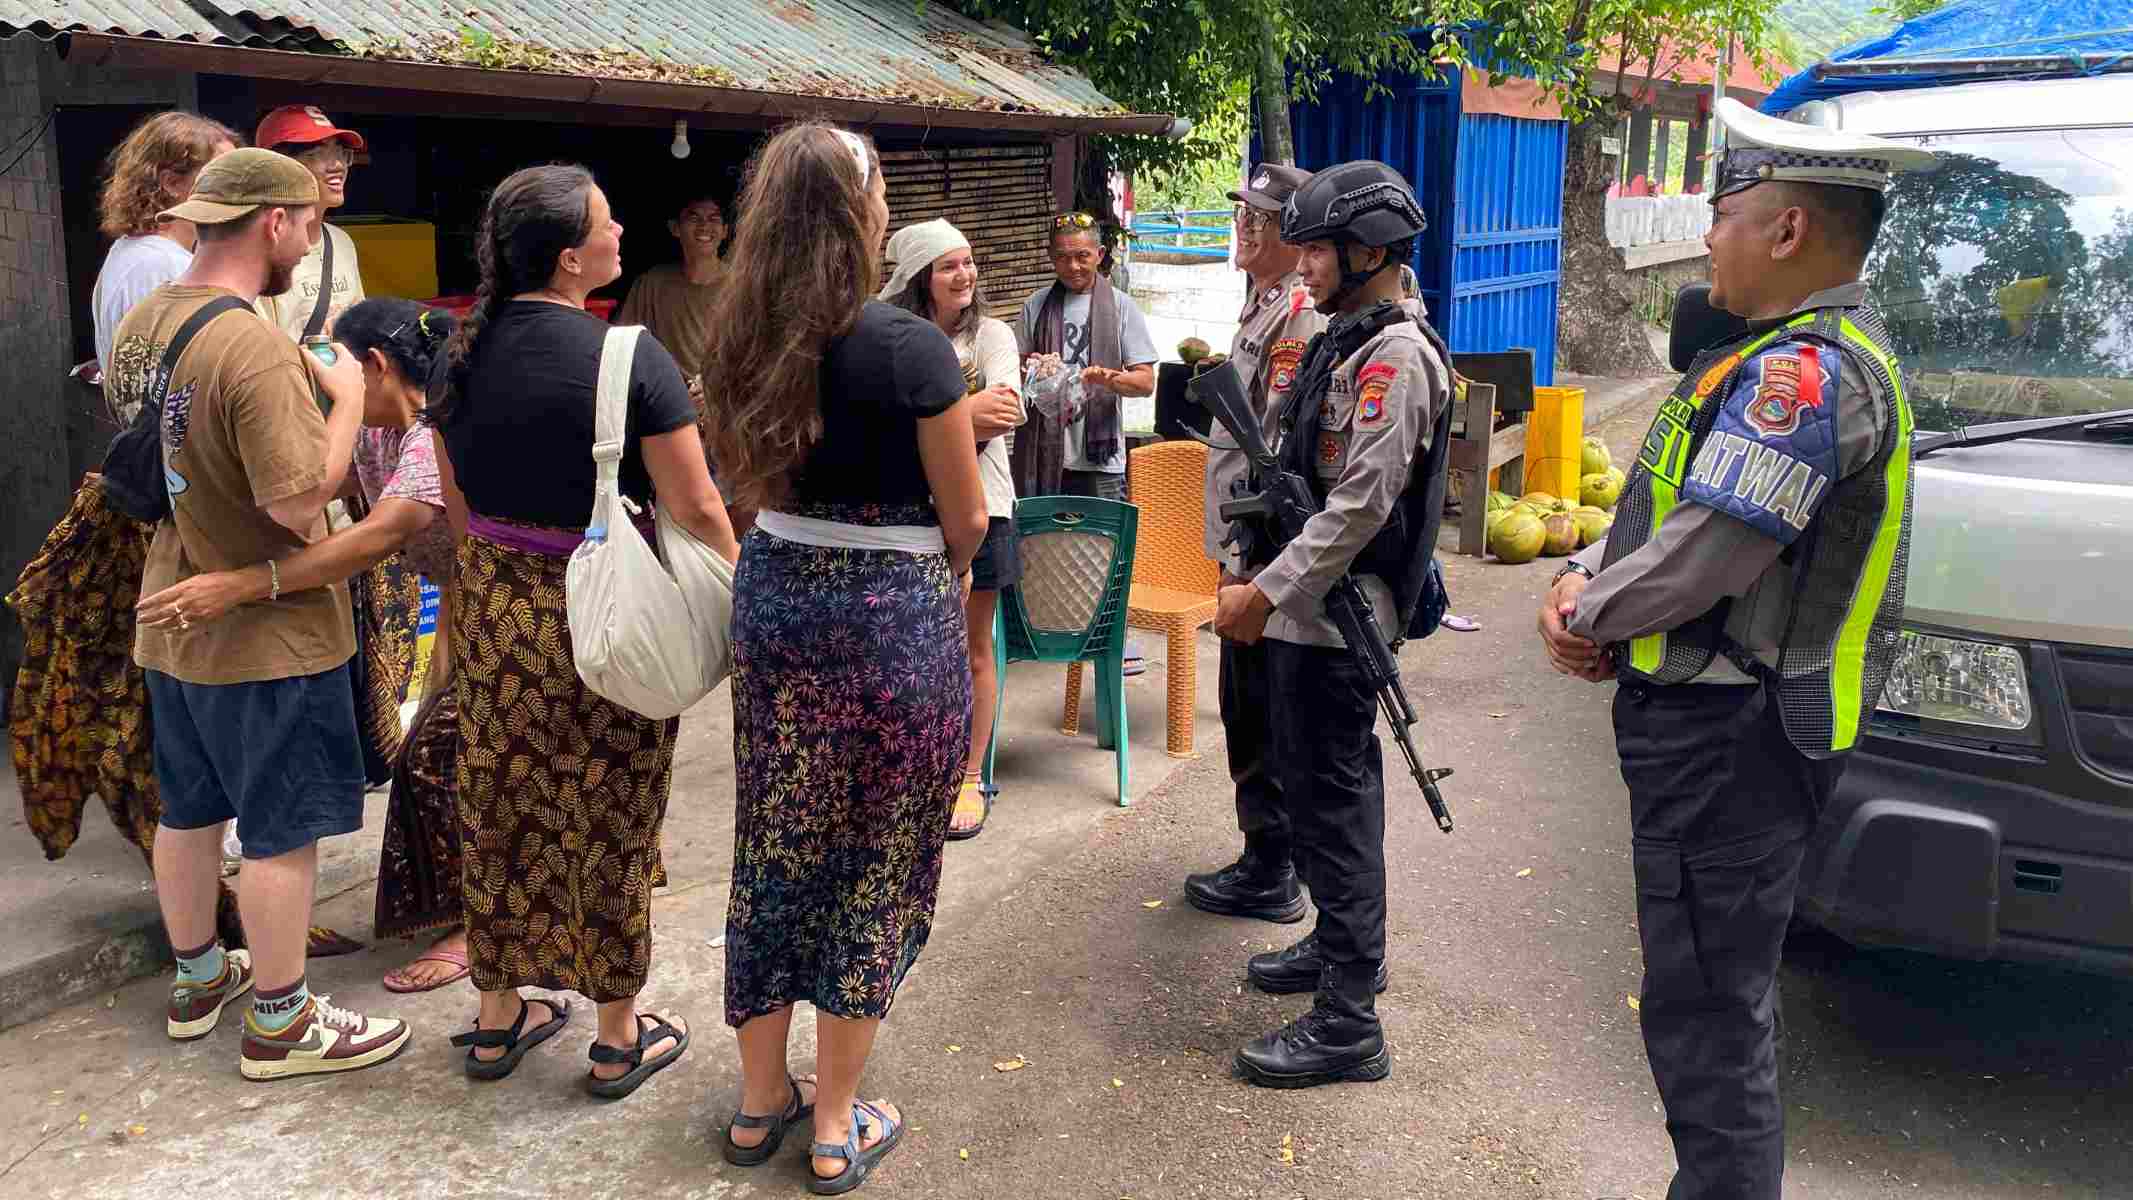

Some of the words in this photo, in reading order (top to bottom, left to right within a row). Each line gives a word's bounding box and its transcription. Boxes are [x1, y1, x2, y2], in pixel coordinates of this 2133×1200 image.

[302, 276, 349, 297] Estial
[1691, 429, 1828, 531] ATWAL
[255, 994, 305, 1014] NIKE
